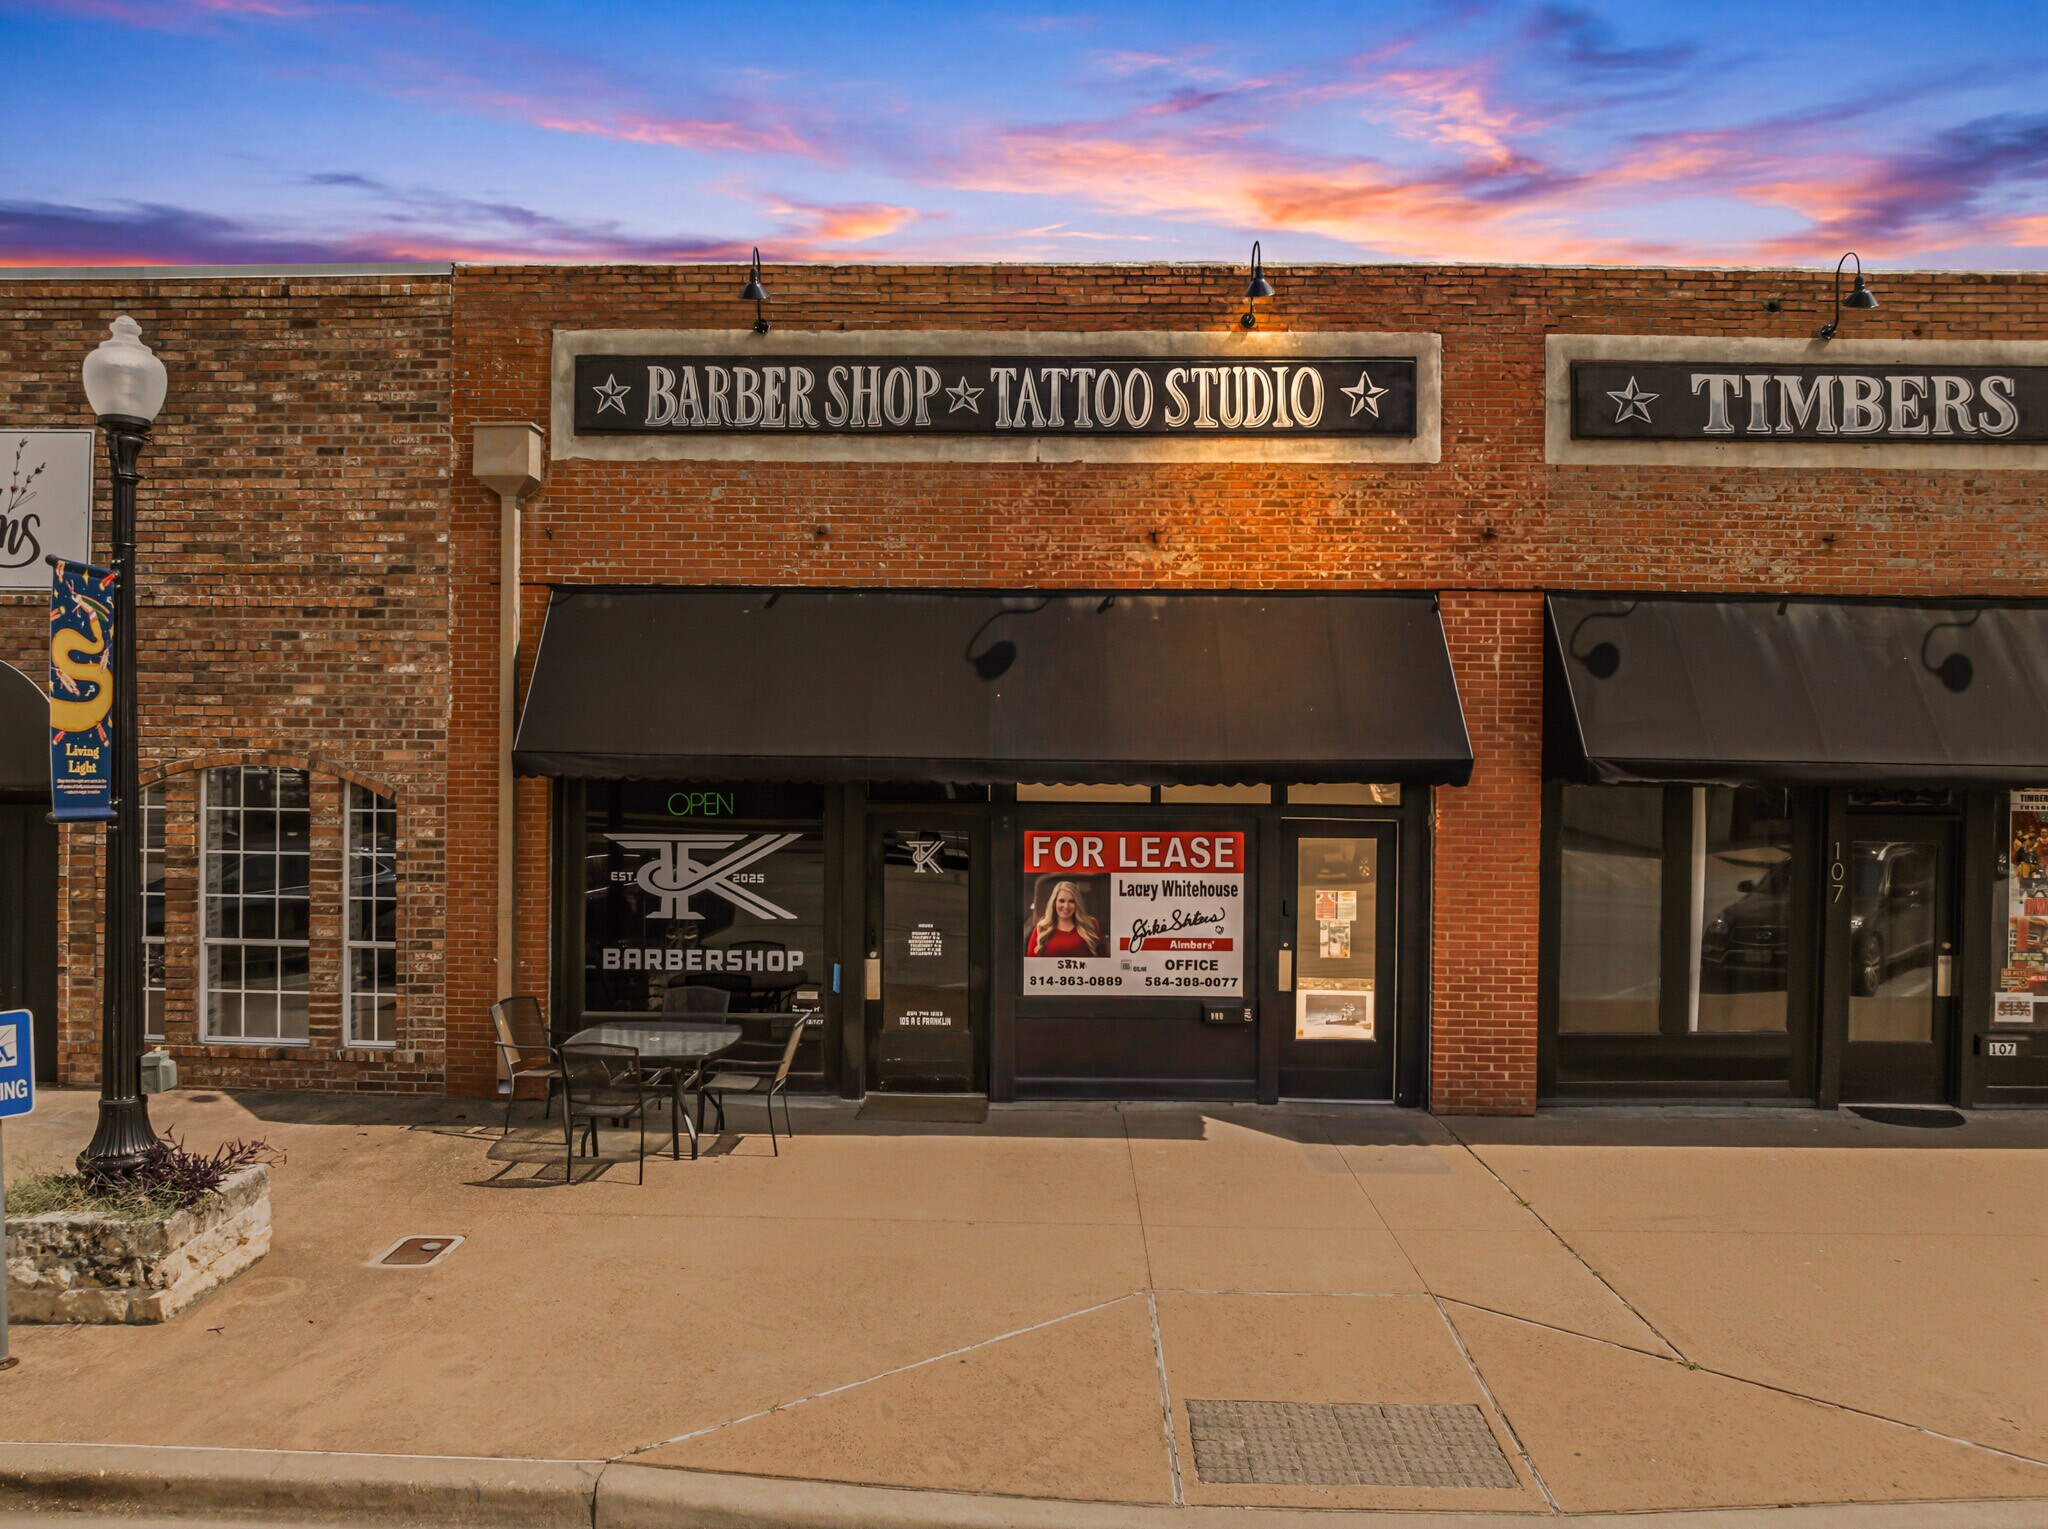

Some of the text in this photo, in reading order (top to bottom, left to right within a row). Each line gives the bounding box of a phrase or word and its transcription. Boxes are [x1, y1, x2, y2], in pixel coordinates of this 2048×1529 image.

[645, 365, 1325, 429] BARBER SHOP TATTOO STUDIO
[1691, 373, 2019, 437] TIMBERS
[65, 743, 99, 759] Living
[68, 760, 97, 775] Light
[667, 792, 734, 816] OPEN
[1032, 836, 1235, 869] FOR LEASE
[732, 873, 765, 884] 2025
[1162, 880, 1239, 898] Whitehouse
[602, 948, 804, 972] BARBERSHOP
[1164, 959, 1219, 971] OFFICE
[1991, 1043, 2014, 1055] 107
